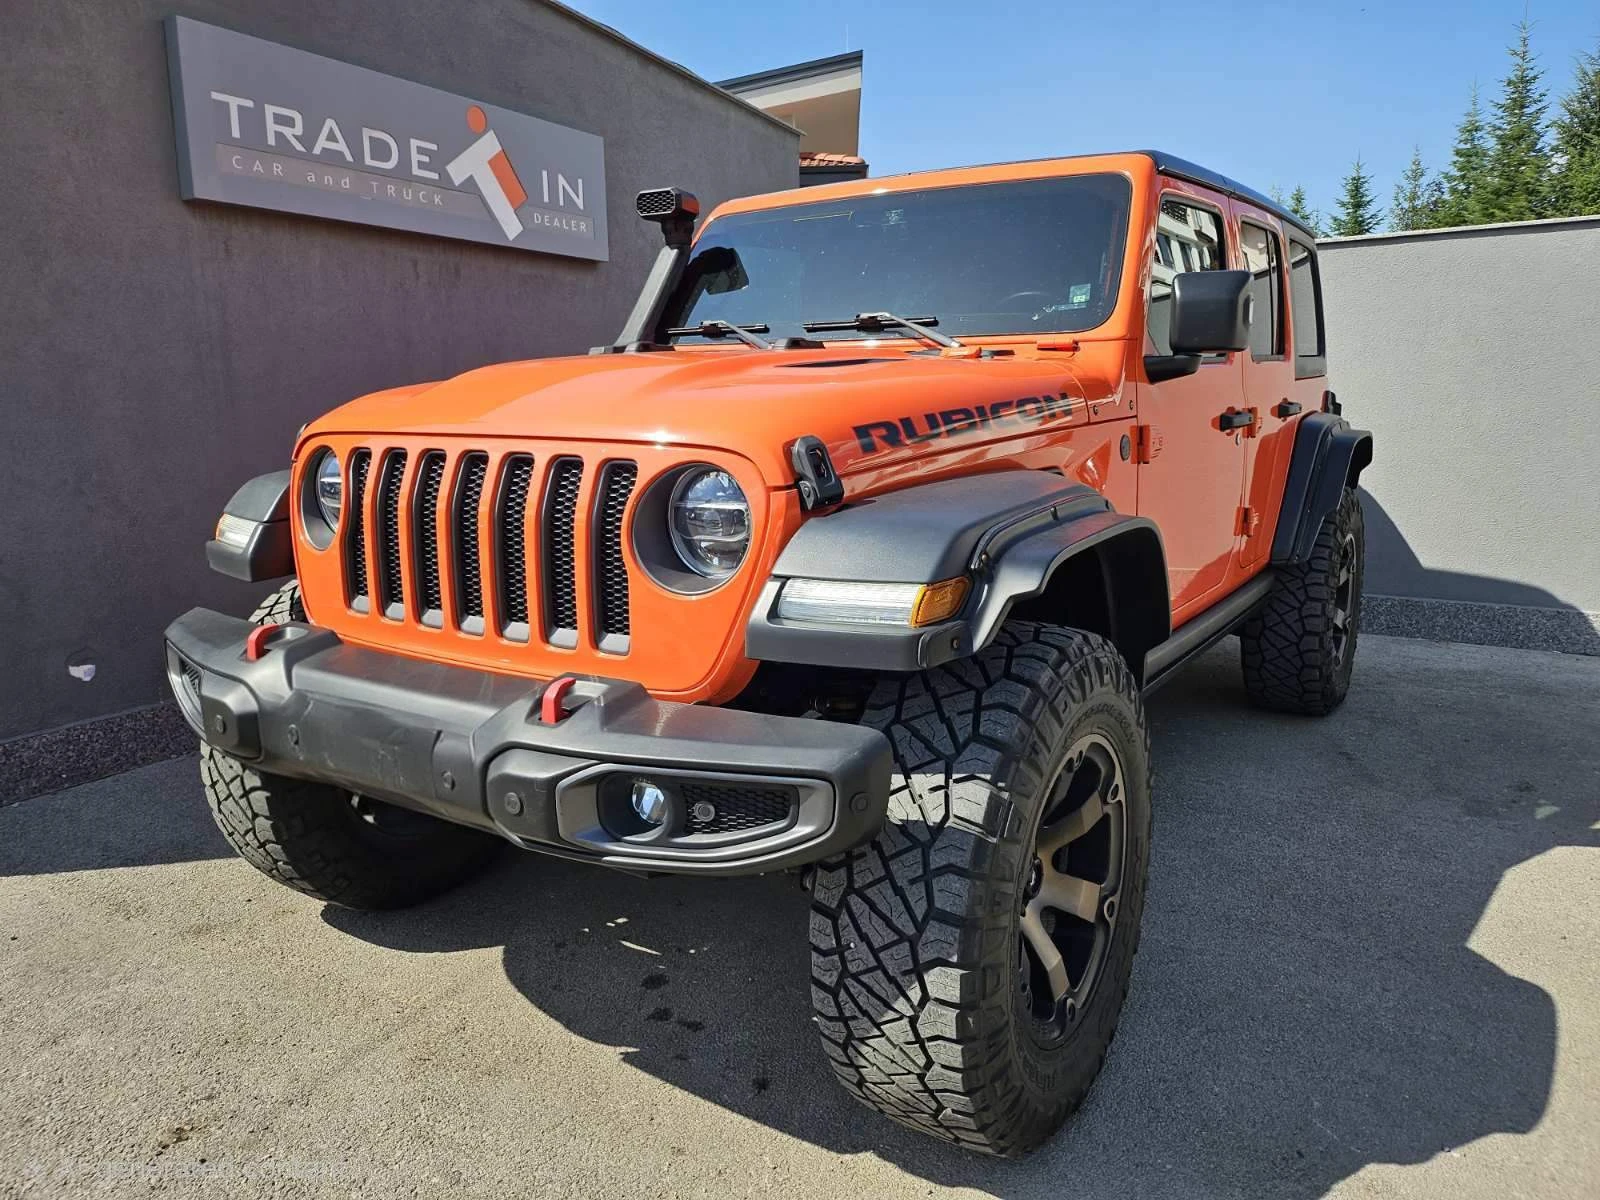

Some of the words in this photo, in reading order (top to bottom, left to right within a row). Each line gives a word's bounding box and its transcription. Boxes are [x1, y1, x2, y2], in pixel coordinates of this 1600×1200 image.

[210, 91, 440, 180] TRADE
[542, 169, 584, 210] IN
[232, 155, 285, 177] CAR
[306, 171, 351, 189] and
[370, 181, 443, 206] TRUCK
[534, 212, 587, 232] DEALER
[851, 392, 1073, 454] RUBICON
